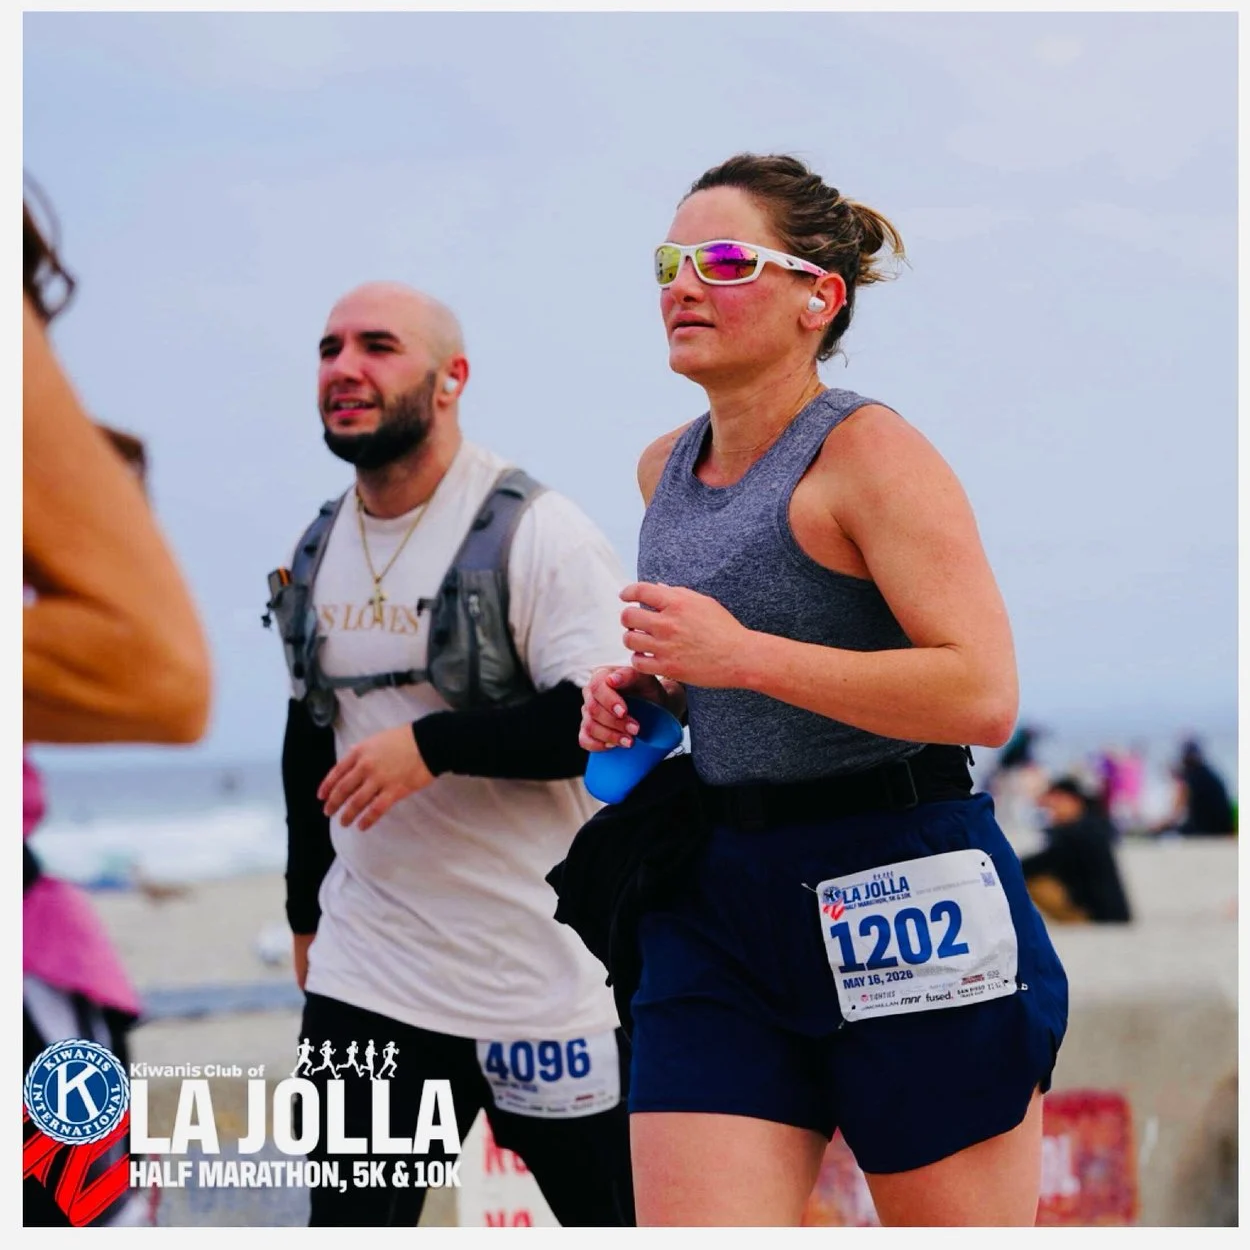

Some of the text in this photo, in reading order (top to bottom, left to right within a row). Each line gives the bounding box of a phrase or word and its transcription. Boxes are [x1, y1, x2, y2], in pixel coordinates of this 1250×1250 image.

[843, 887, 862, 904] LA
[865, 876, 910, 900] JOLLA
[830, 900, 970, 973] 1202
[843, 976, 865, 989] MAY
[485, 1038, 591, 1082] 4096
